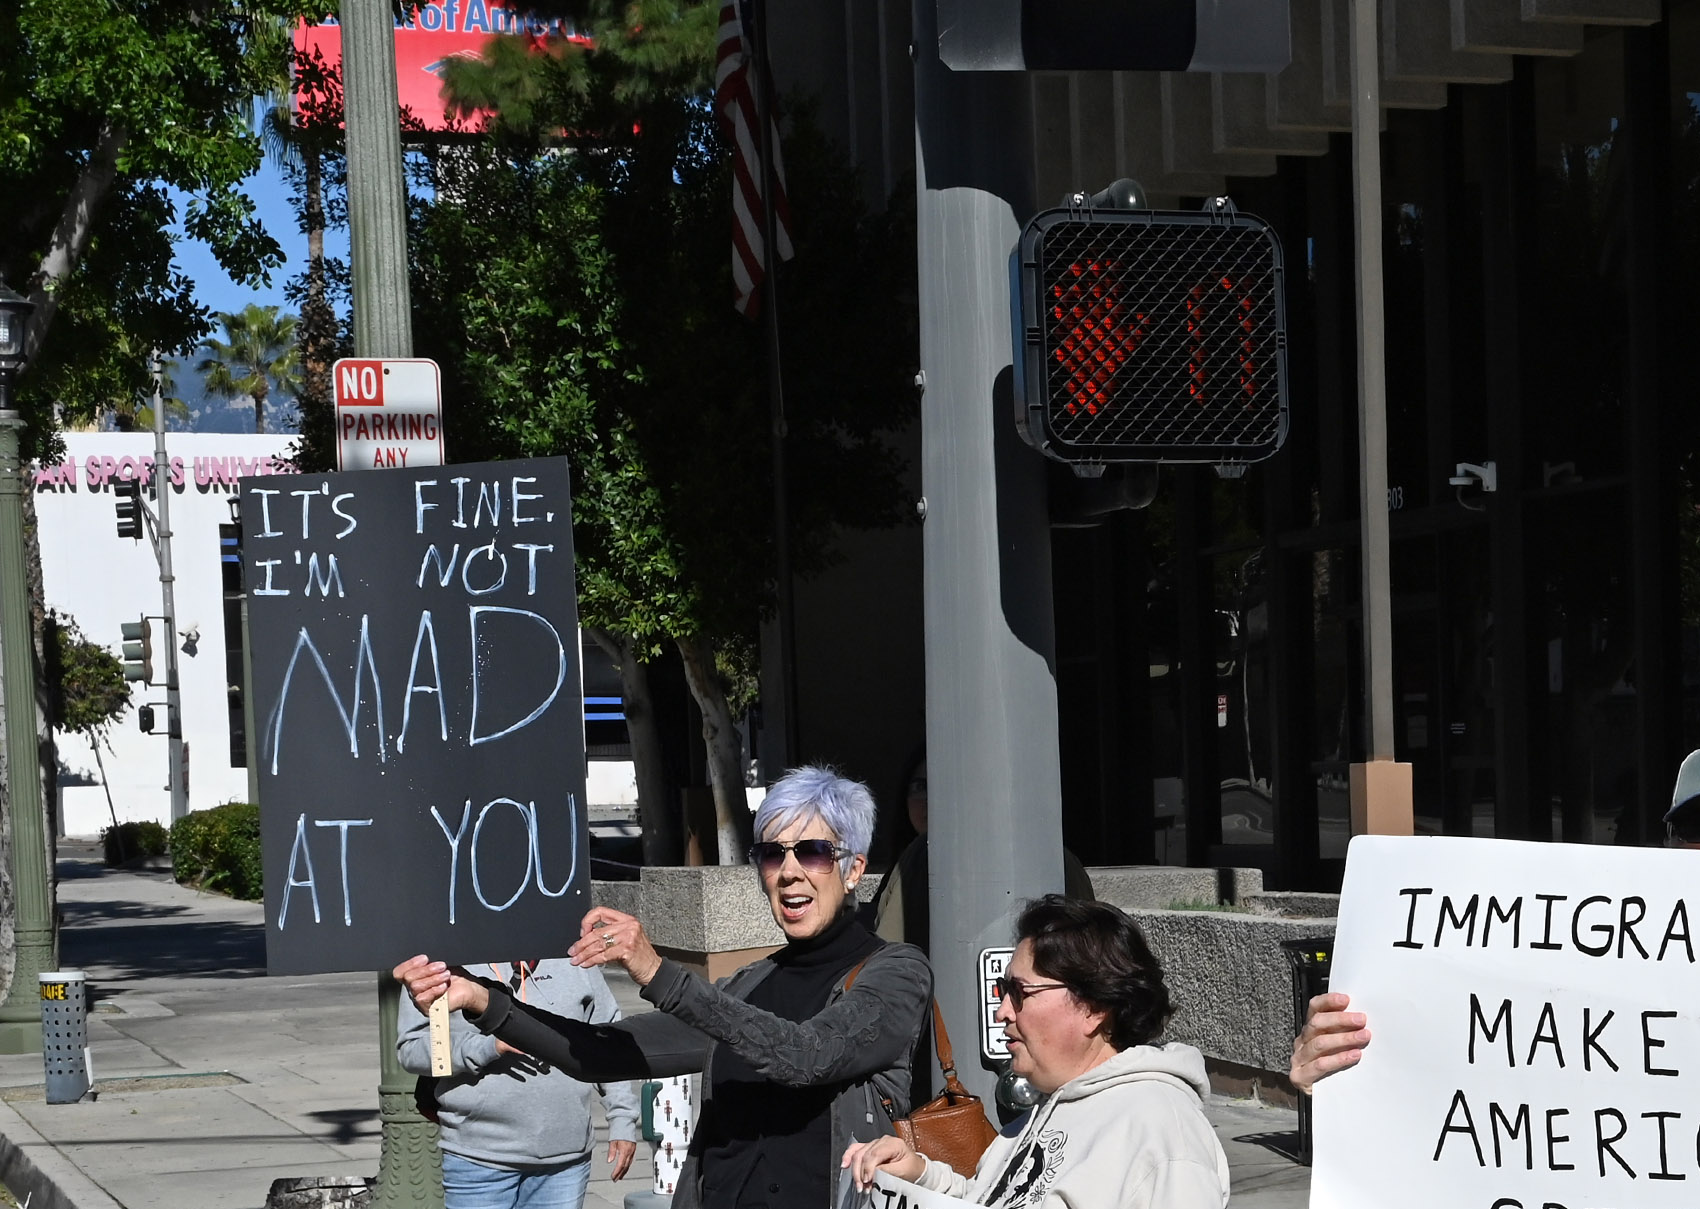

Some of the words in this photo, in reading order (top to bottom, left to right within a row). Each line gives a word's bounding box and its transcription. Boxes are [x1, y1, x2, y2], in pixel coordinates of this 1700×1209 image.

[341, 366, 377, 399] NO
[343, 413, 436, 440] PARKING
[85, 455, 184, 486] SPORS
[374, 447, 408, 467] ANY
[250, 481, 357, 539] IT'S
[415, 476, 554, 534] FINE.
[253, 550, 345, 597] I'M
[416, 542, 554, 596] NOT
[267, 604, 568, 776] MAD
[278, 812, 373, 931] AT
[1467, 992, 1680, 1077] MAKE
